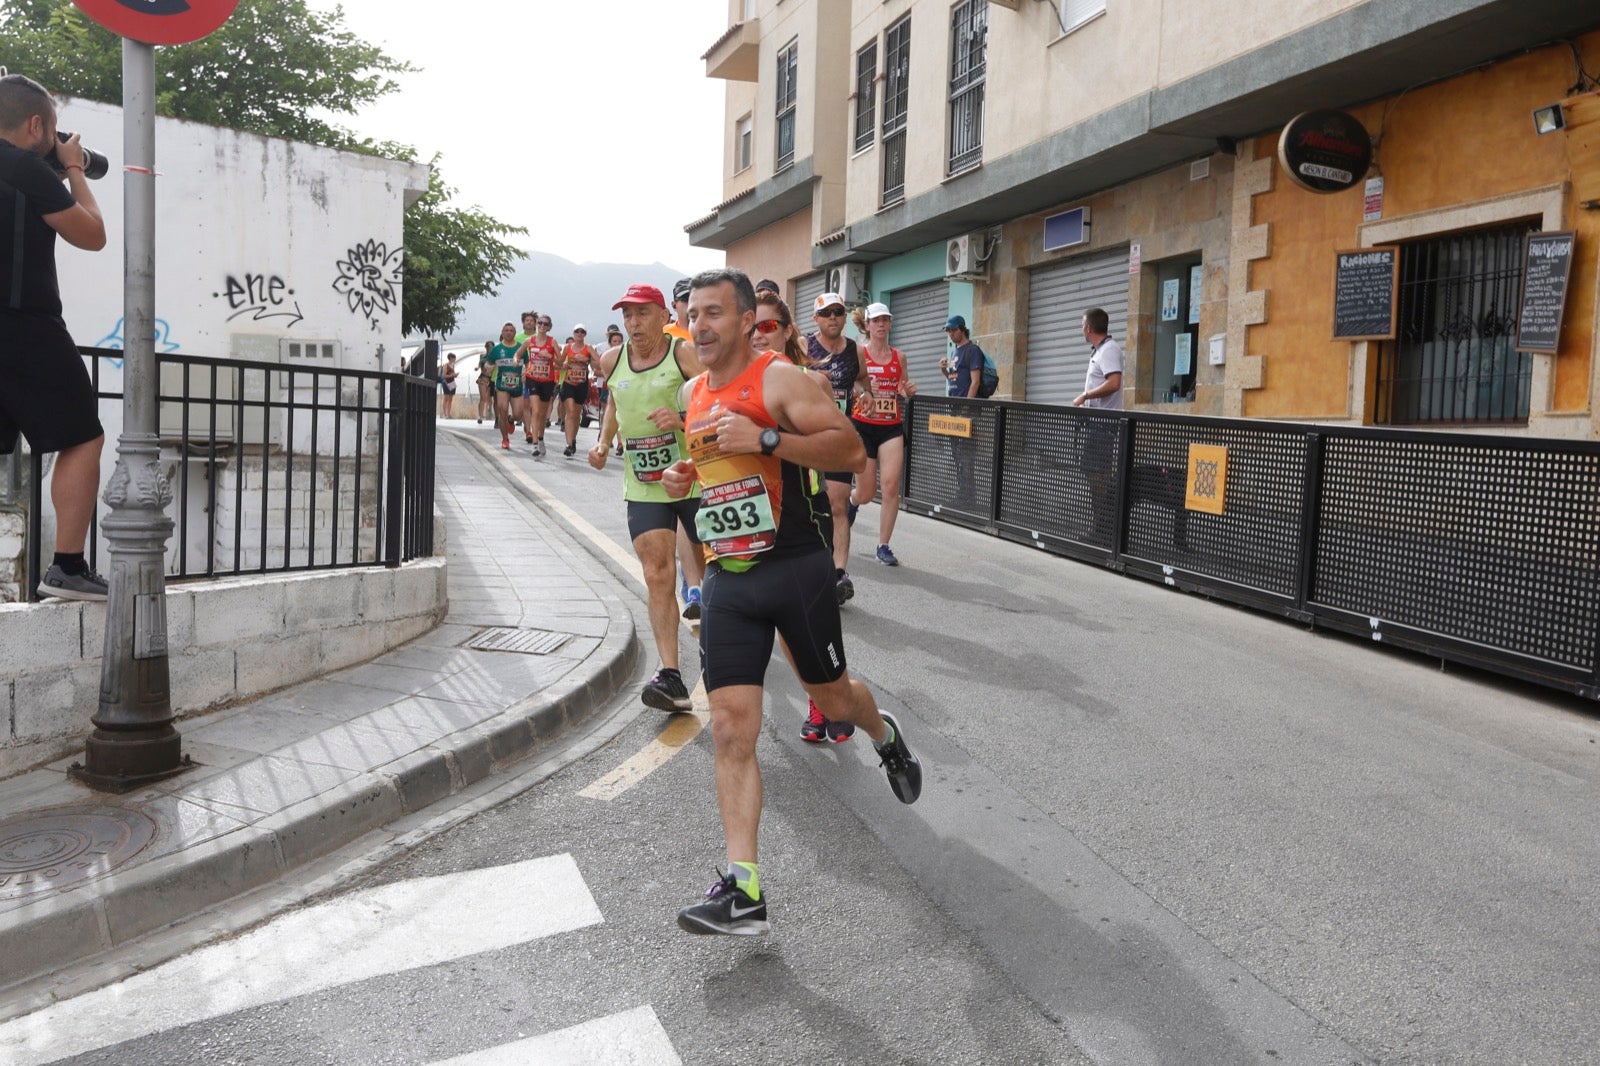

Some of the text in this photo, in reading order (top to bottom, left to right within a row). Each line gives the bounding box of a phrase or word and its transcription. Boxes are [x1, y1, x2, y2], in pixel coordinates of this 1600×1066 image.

[636, 448, 672, 468] 353
[715, 483, 734, 496] PREMIO
[735, 481, 743, 491] DE
[742, 478, 760, 490] FONDO
[705, 501, 760, 534] 393
